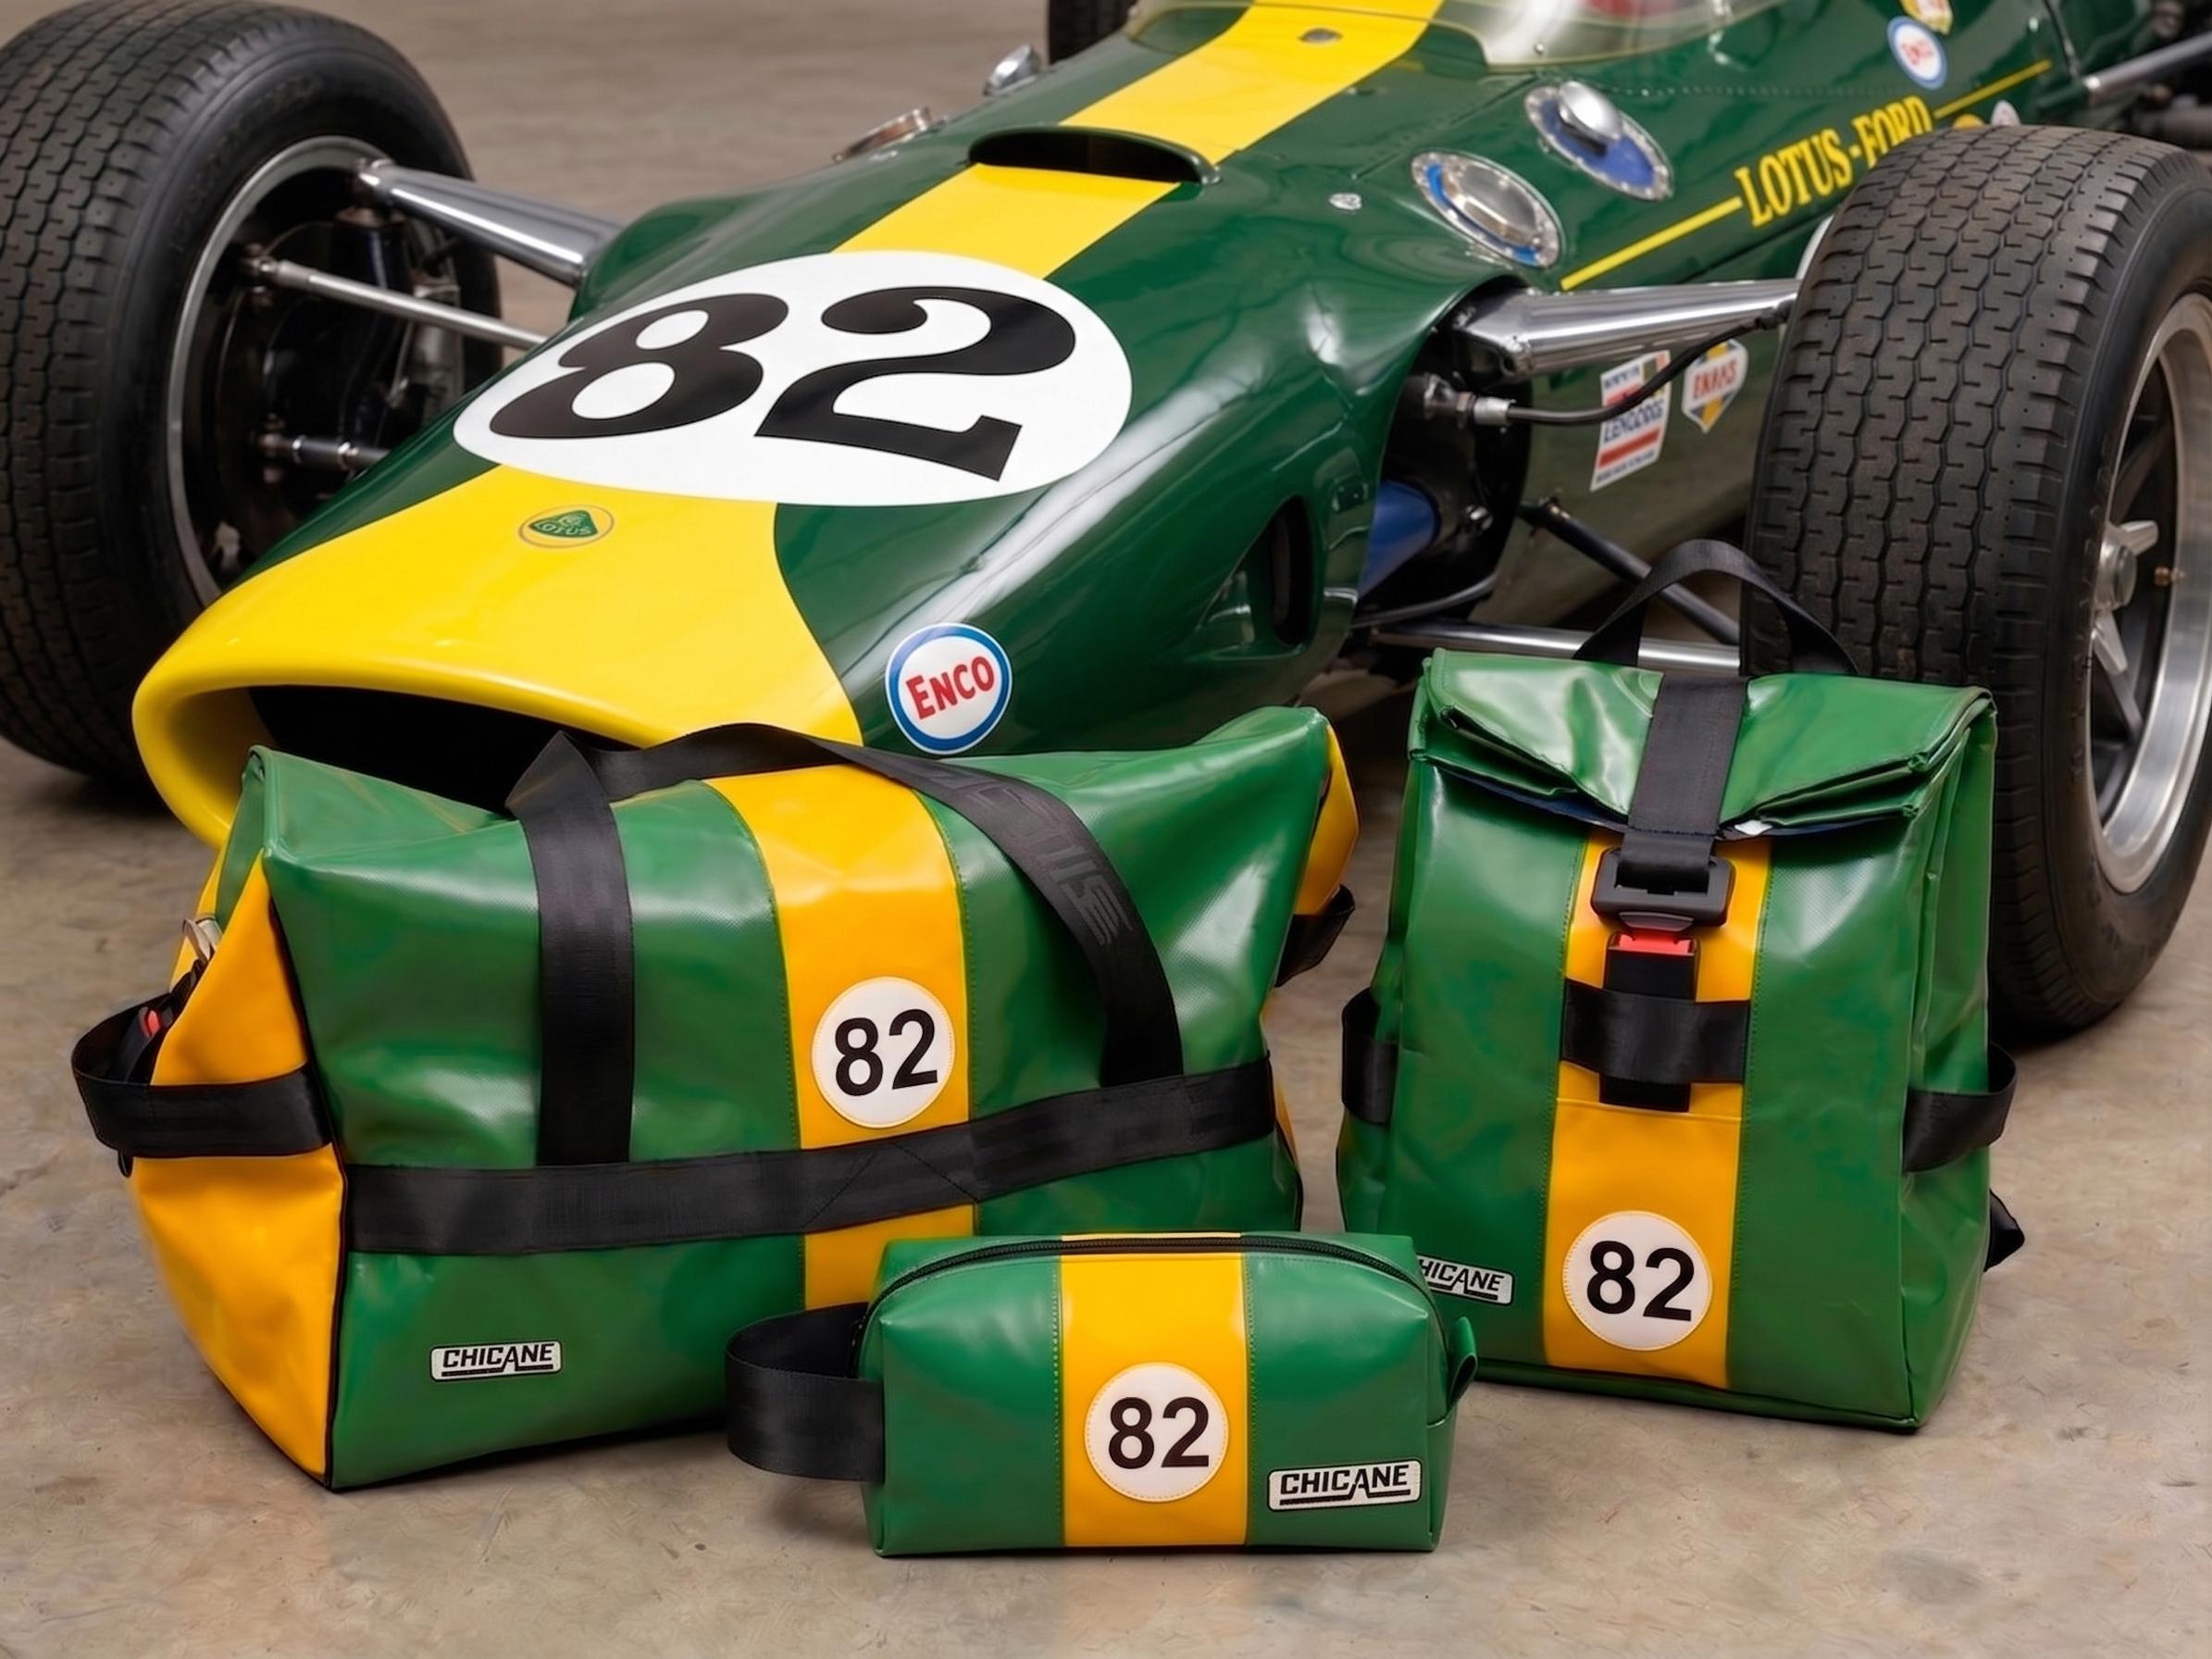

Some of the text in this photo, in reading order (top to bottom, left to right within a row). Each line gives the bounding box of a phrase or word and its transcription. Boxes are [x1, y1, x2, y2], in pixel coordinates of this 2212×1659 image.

[489, 285, 1076, 482] 82
[533, 520, 591, 536] LOTUS
[905, 655, 995, 720] ENCO
[835, 1008, 938, 1097] 82
[1419, 1259, 1504, 1294] HICANE
[1586, 1240, 1696, 1322] 82
[442, 1342, 555, 1373] CHICANE
[1108, 1396, 1210, 1470] 82
[1279, 1465, 1410, 1499] CHICANE
